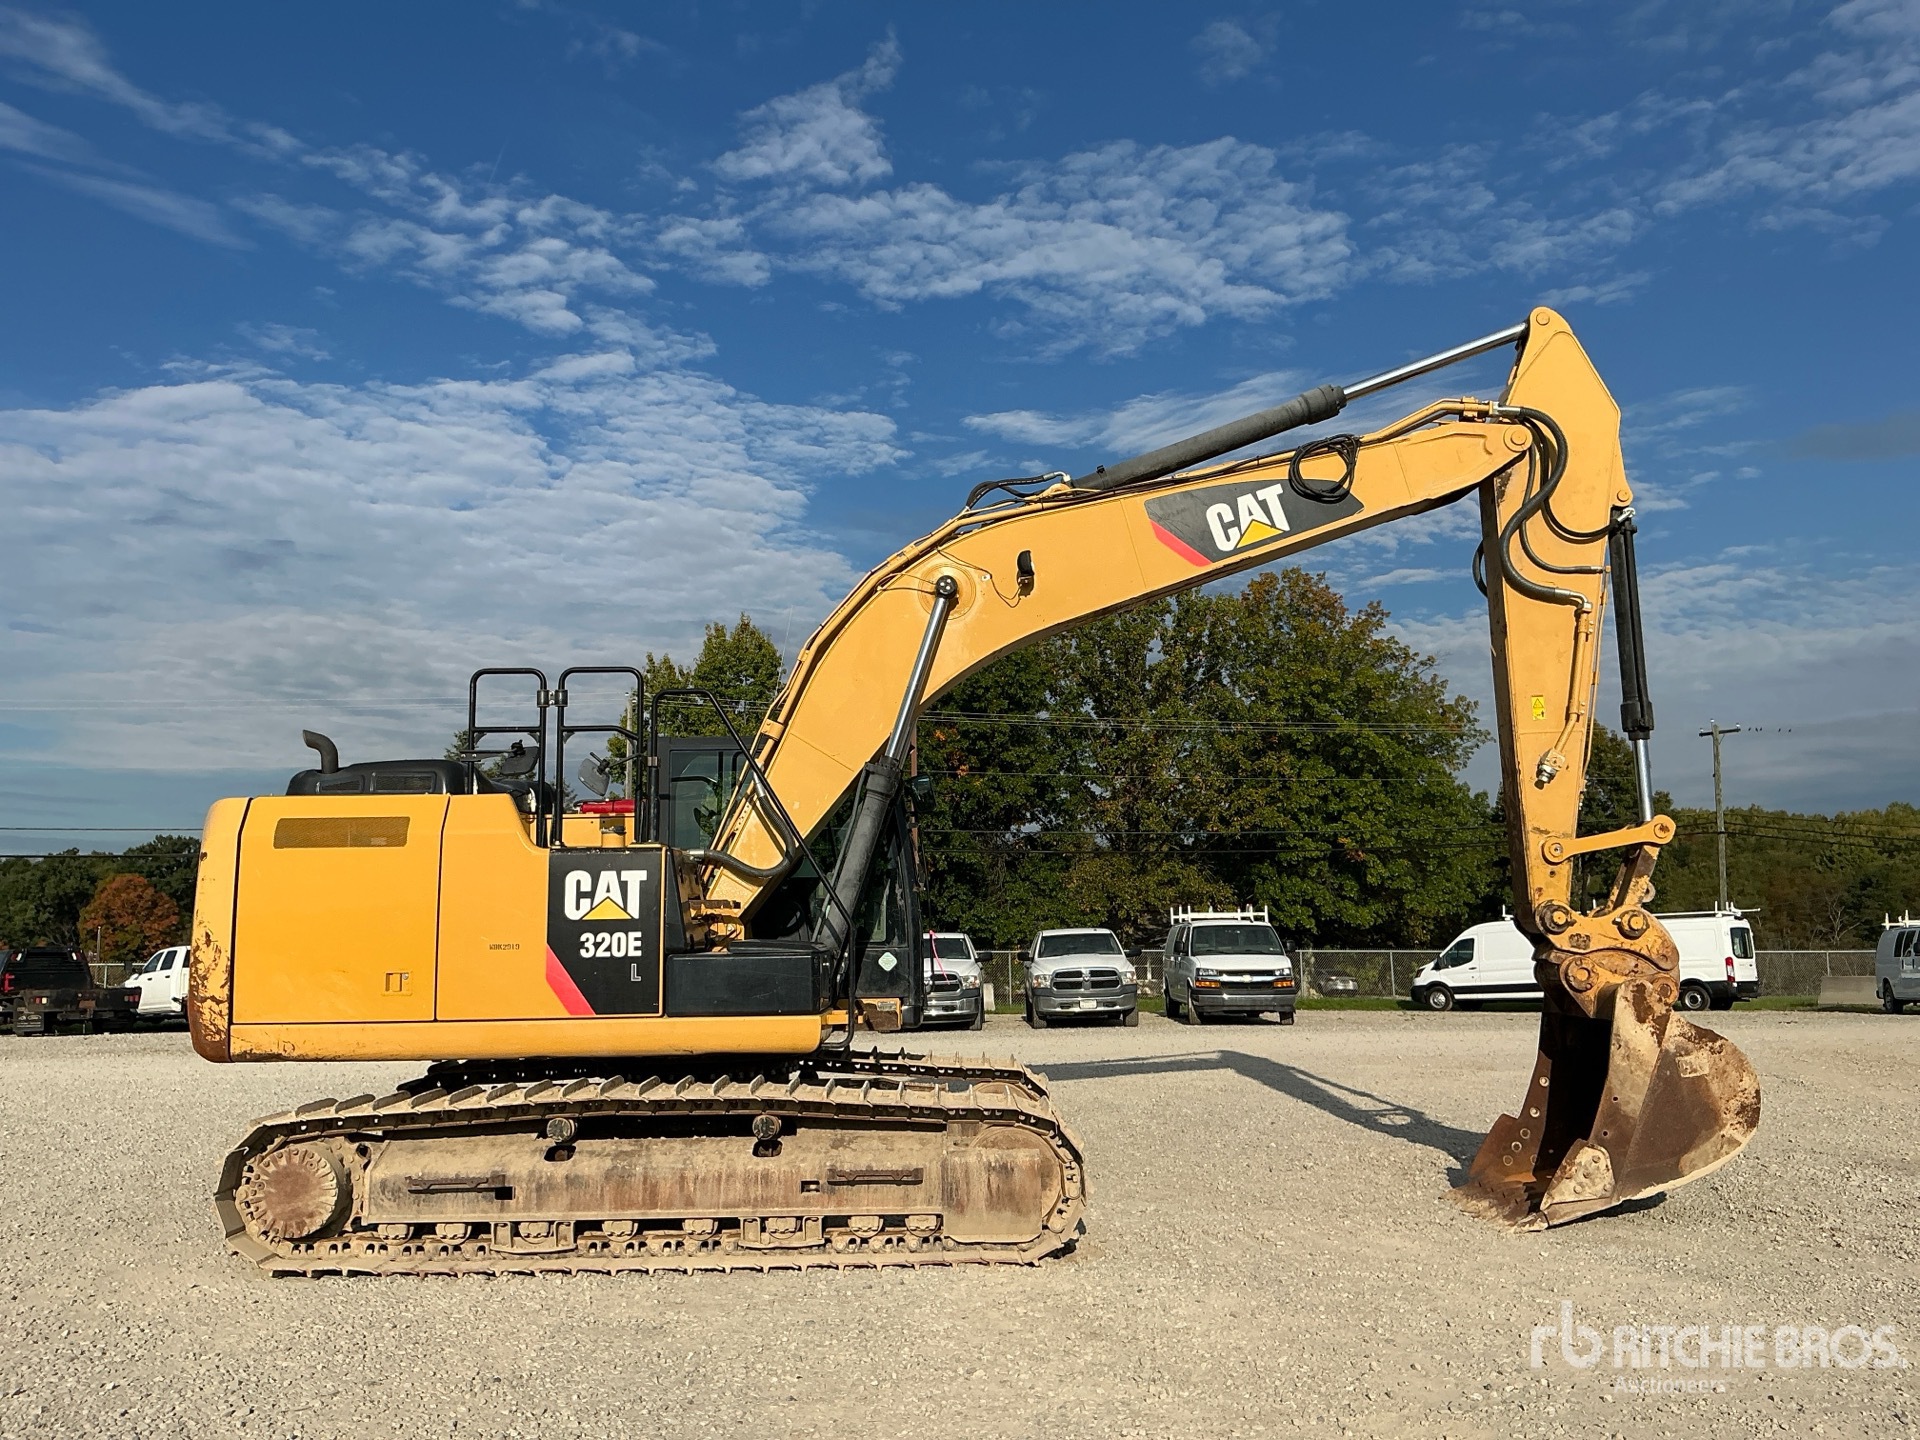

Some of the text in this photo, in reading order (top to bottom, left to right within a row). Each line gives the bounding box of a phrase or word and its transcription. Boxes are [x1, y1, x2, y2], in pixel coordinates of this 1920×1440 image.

[1206, 483, 1291, 552] CAT
[564, 869, 648, 920] CAT
[579, 931, 642, 958] 320E
[630, 963, 642, 982] L
